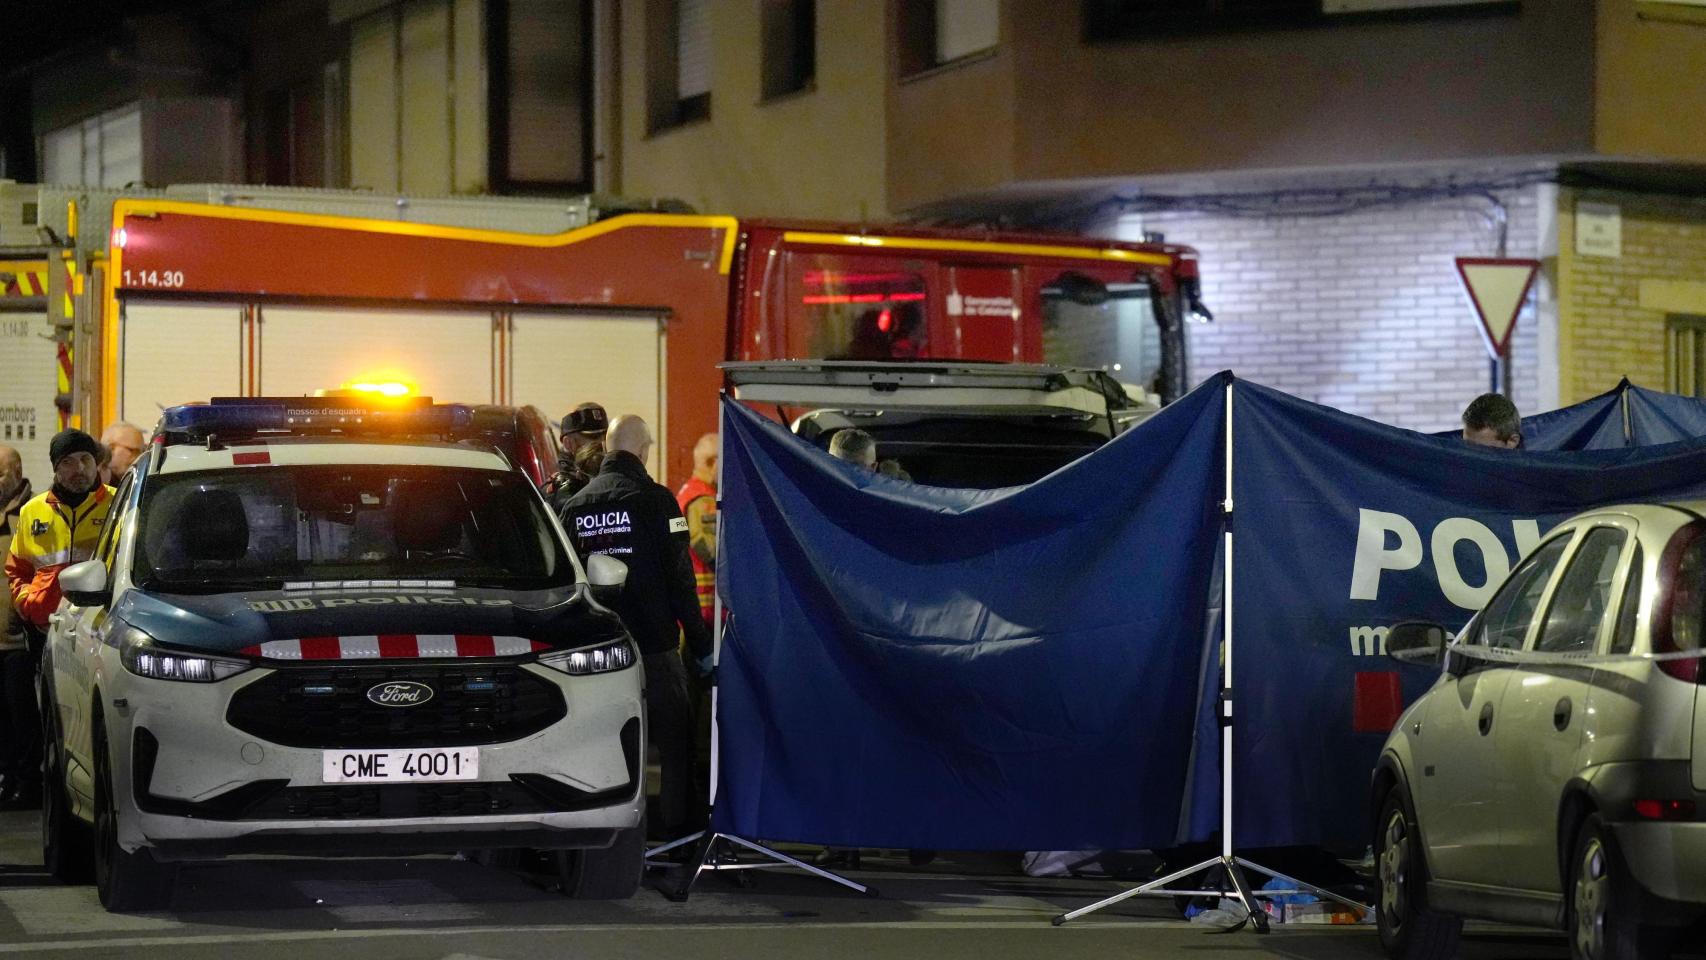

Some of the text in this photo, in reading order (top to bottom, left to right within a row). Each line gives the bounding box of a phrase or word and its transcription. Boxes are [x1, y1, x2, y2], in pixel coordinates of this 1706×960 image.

[124, 269, 184, 287] 1.14.30
[287, 407, 367, 417] mossos d'esquadra
[576, 511, 631, 530] POLICIA
[609, 546, 633, 555] Criminal
[379, 685, 420, 702] Ford
[342, 752, 460, 777] CME 4001
